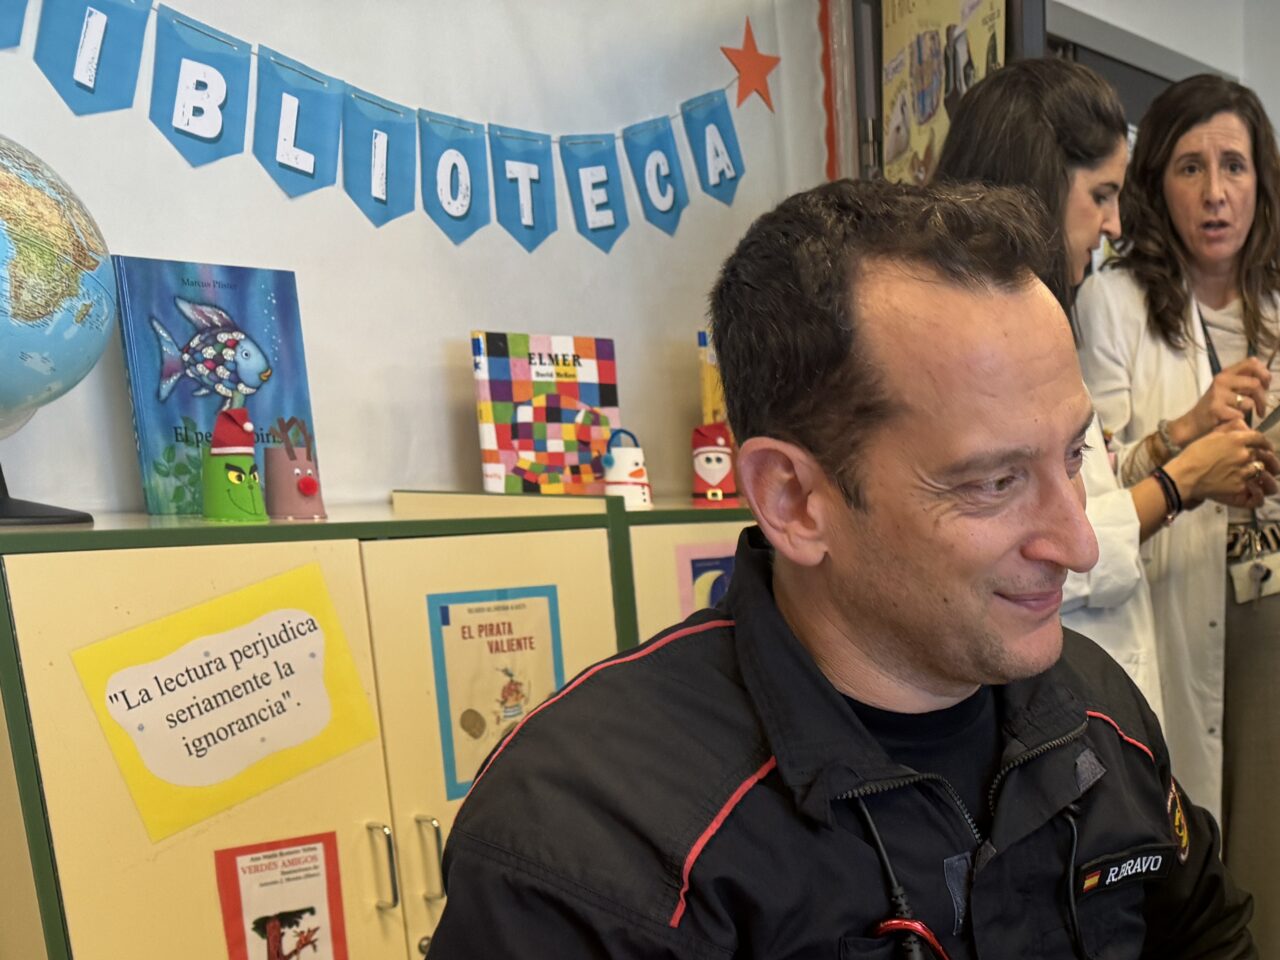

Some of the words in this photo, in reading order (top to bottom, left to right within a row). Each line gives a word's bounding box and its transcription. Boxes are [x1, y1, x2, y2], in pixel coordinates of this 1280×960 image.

[527, 351, 583, 368] ELMER
[173, 426, 188, 444] El
[460, 625, 474, 640] EL
[478, 621, 514, 638] PIRATA
[487, 636, 536, 654] VALIENTE
[108, 686, 153, 711] "La
[154, 655, 227, 697] lectura
[229, 616, 318, 671] perjudica
[165, 670, 273, 730] seriamente
[273, 659, 296, 682] la
[240, 860, 279, 875] VERDES
[281, 854, 319, 869] AMIGOS
